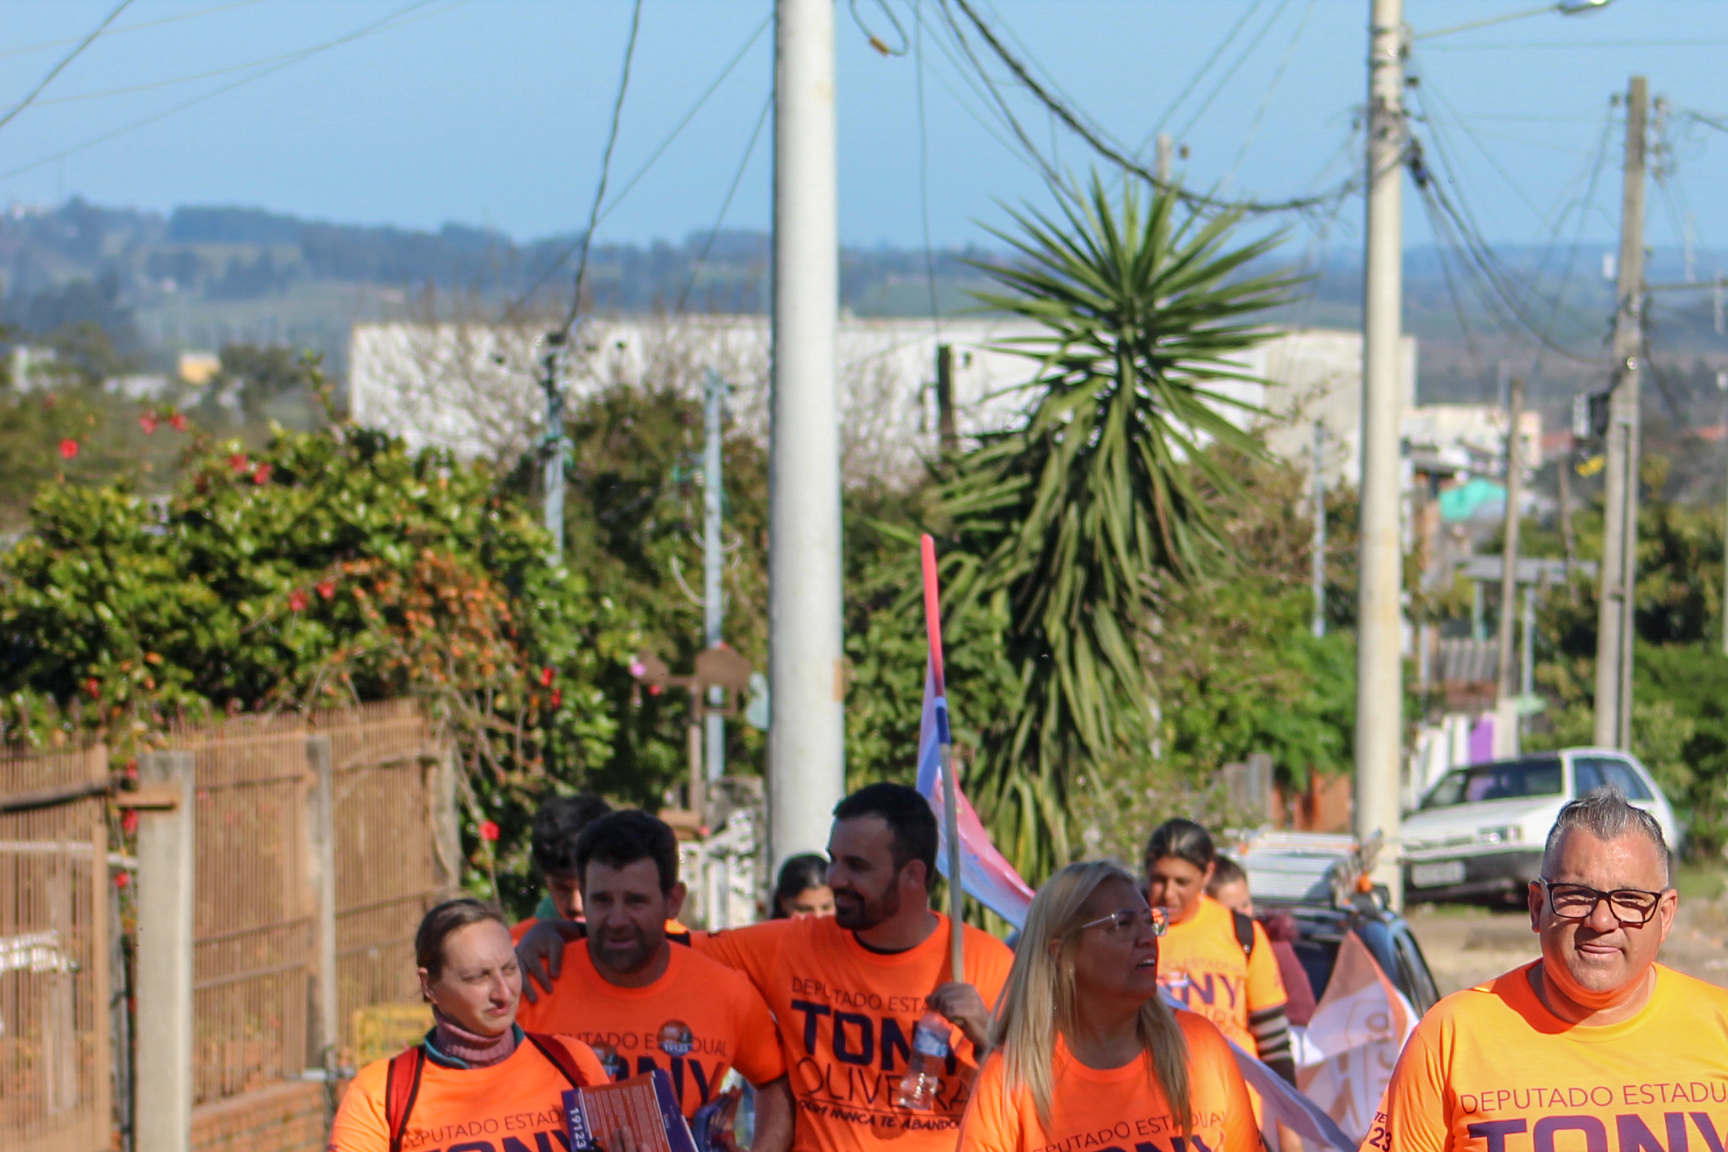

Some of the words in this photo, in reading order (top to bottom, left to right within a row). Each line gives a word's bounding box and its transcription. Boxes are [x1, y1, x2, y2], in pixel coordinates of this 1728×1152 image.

[1460, 1086, 1613, 1115] DEPUTADO
[569, 1107, 587, 1149] 19123
[880, 1113, 897, 1128] TE
